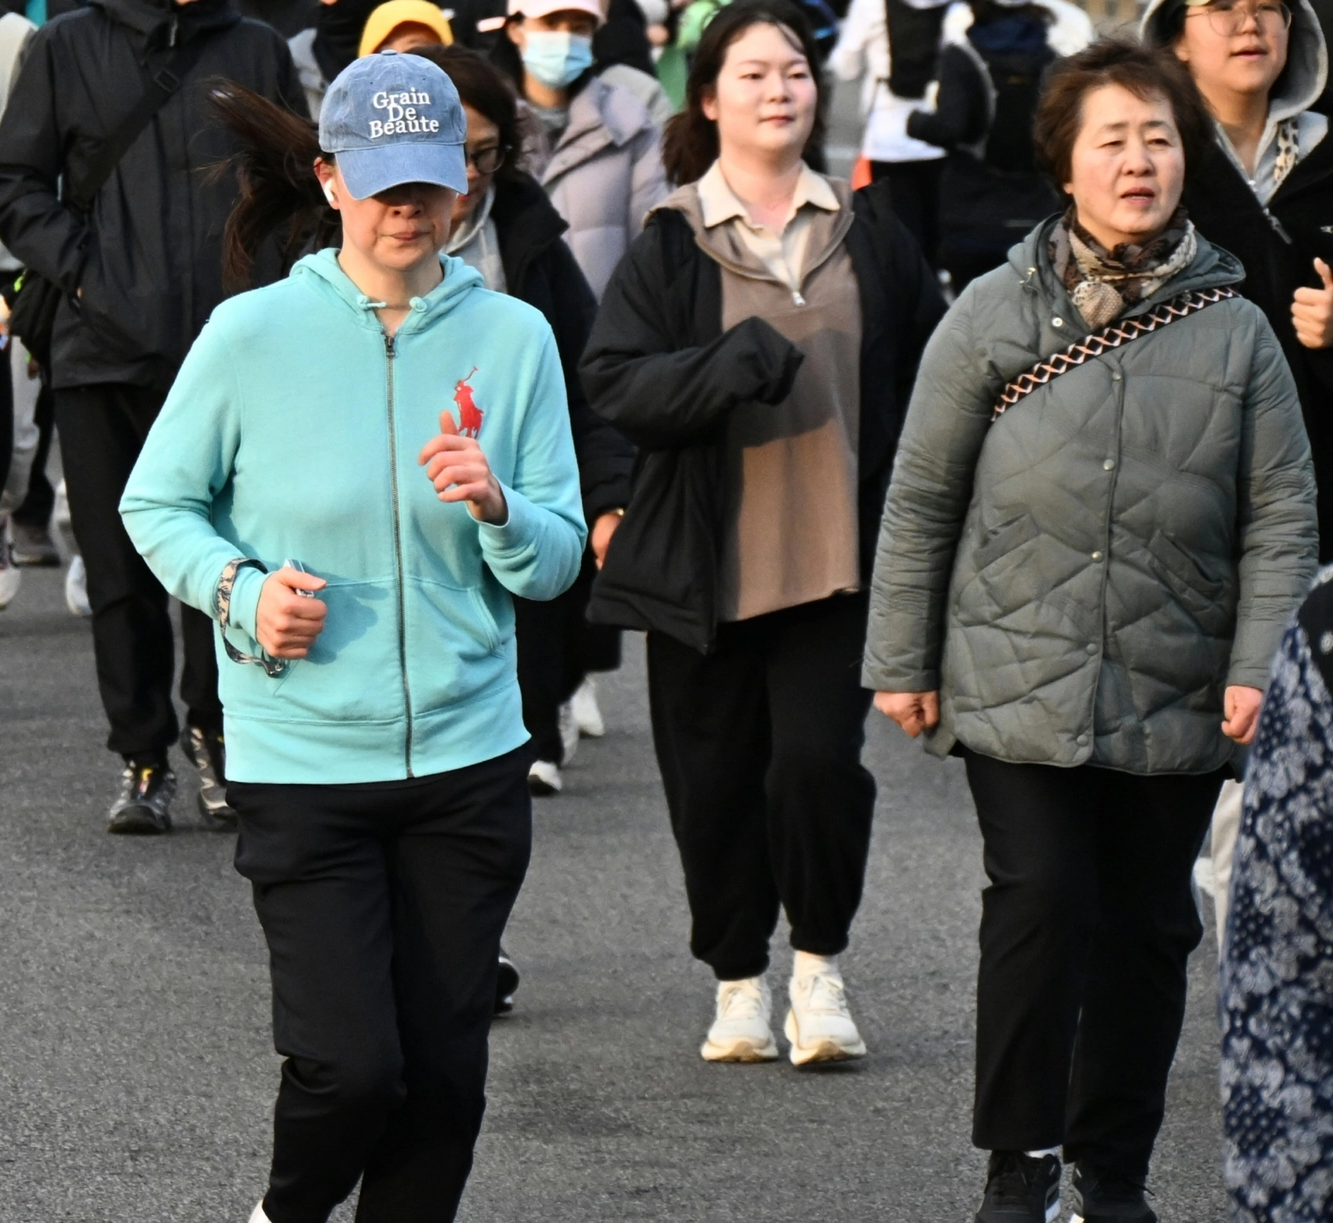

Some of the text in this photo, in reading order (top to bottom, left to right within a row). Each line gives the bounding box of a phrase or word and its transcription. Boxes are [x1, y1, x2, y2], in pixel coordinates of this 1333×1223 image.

[373, 87, 431, 109] Grain
[387, 103, 417, 122] De
[369, 116, 439, 139] Beaute
